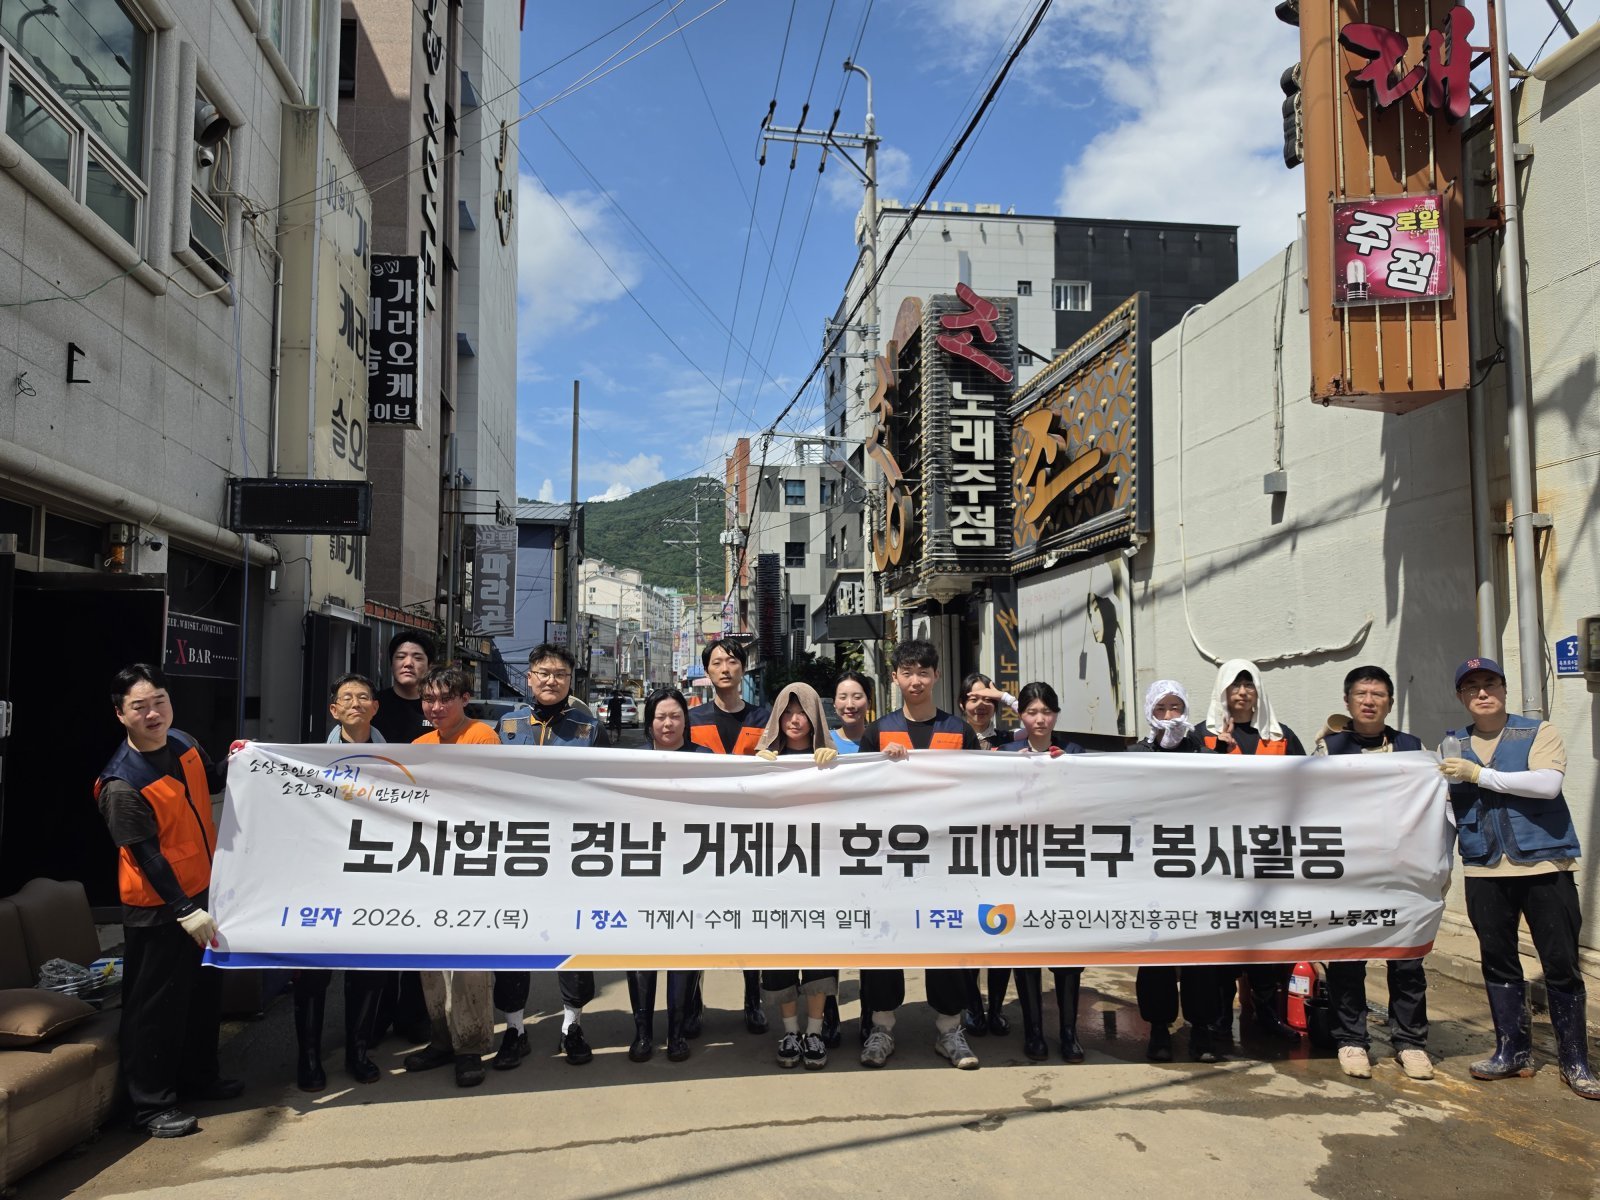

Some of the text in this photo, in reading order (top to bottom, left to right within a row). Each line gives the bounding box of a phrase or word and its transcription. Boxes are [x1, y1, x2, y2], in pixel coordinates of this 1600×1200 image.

[1397, 209, 1440, 231] 로얄
[1346, 211, 1436, 294] 주점
[371, 260, 400, 277] ew
[386, 279, 415, 398] 가라오케
[368, 403, 411, 420] 이브
[950, 382, 997, 547] 노래주점
[480, 553, 511, 631] 파라곤
[250, 760, 361, 783] 소상공인의 가치
[283, 781, 338, 799] 소진공이
[376, 788, 431, 804] 만듭니다
[343, 819, 1346, 880] 노사합동 경남 거제시 호우 피해복구 봉사활동
[300, 907, 528, 929] 일자 2026. 8.27.(목)
[591, 910, 870, 929] 장소 거제시 수해 피해지역 일대
[929, 909, 1397, 930] 주관 소상공인시장진흥공단 경남지역본부, 노동조합
